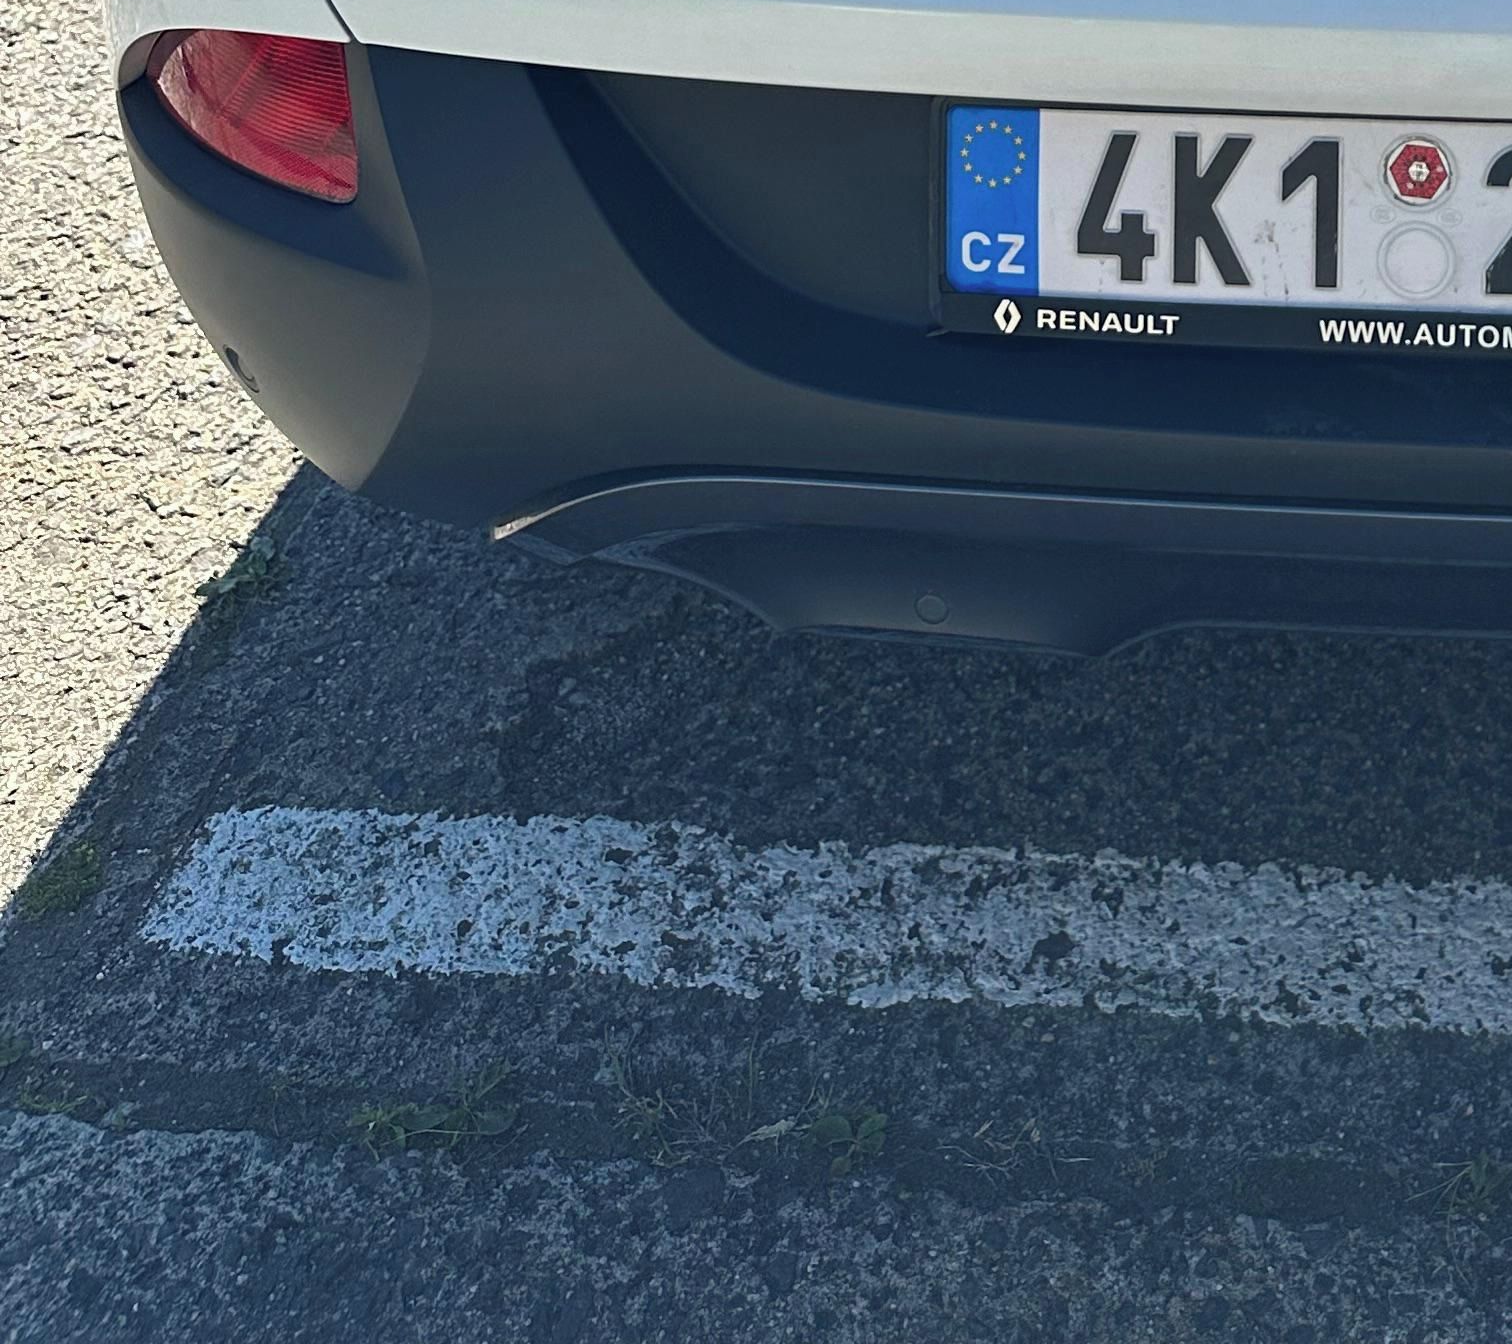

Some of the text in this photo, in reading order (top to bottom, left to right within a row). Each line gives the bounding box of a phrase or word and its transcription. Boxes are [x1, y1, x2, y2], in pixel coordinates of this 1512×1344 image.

[1076, 131, 1341, 289] 4K1
[961, 231, 1025, 274] CZ
[1036, 308, 1181, 335] RENAULT
